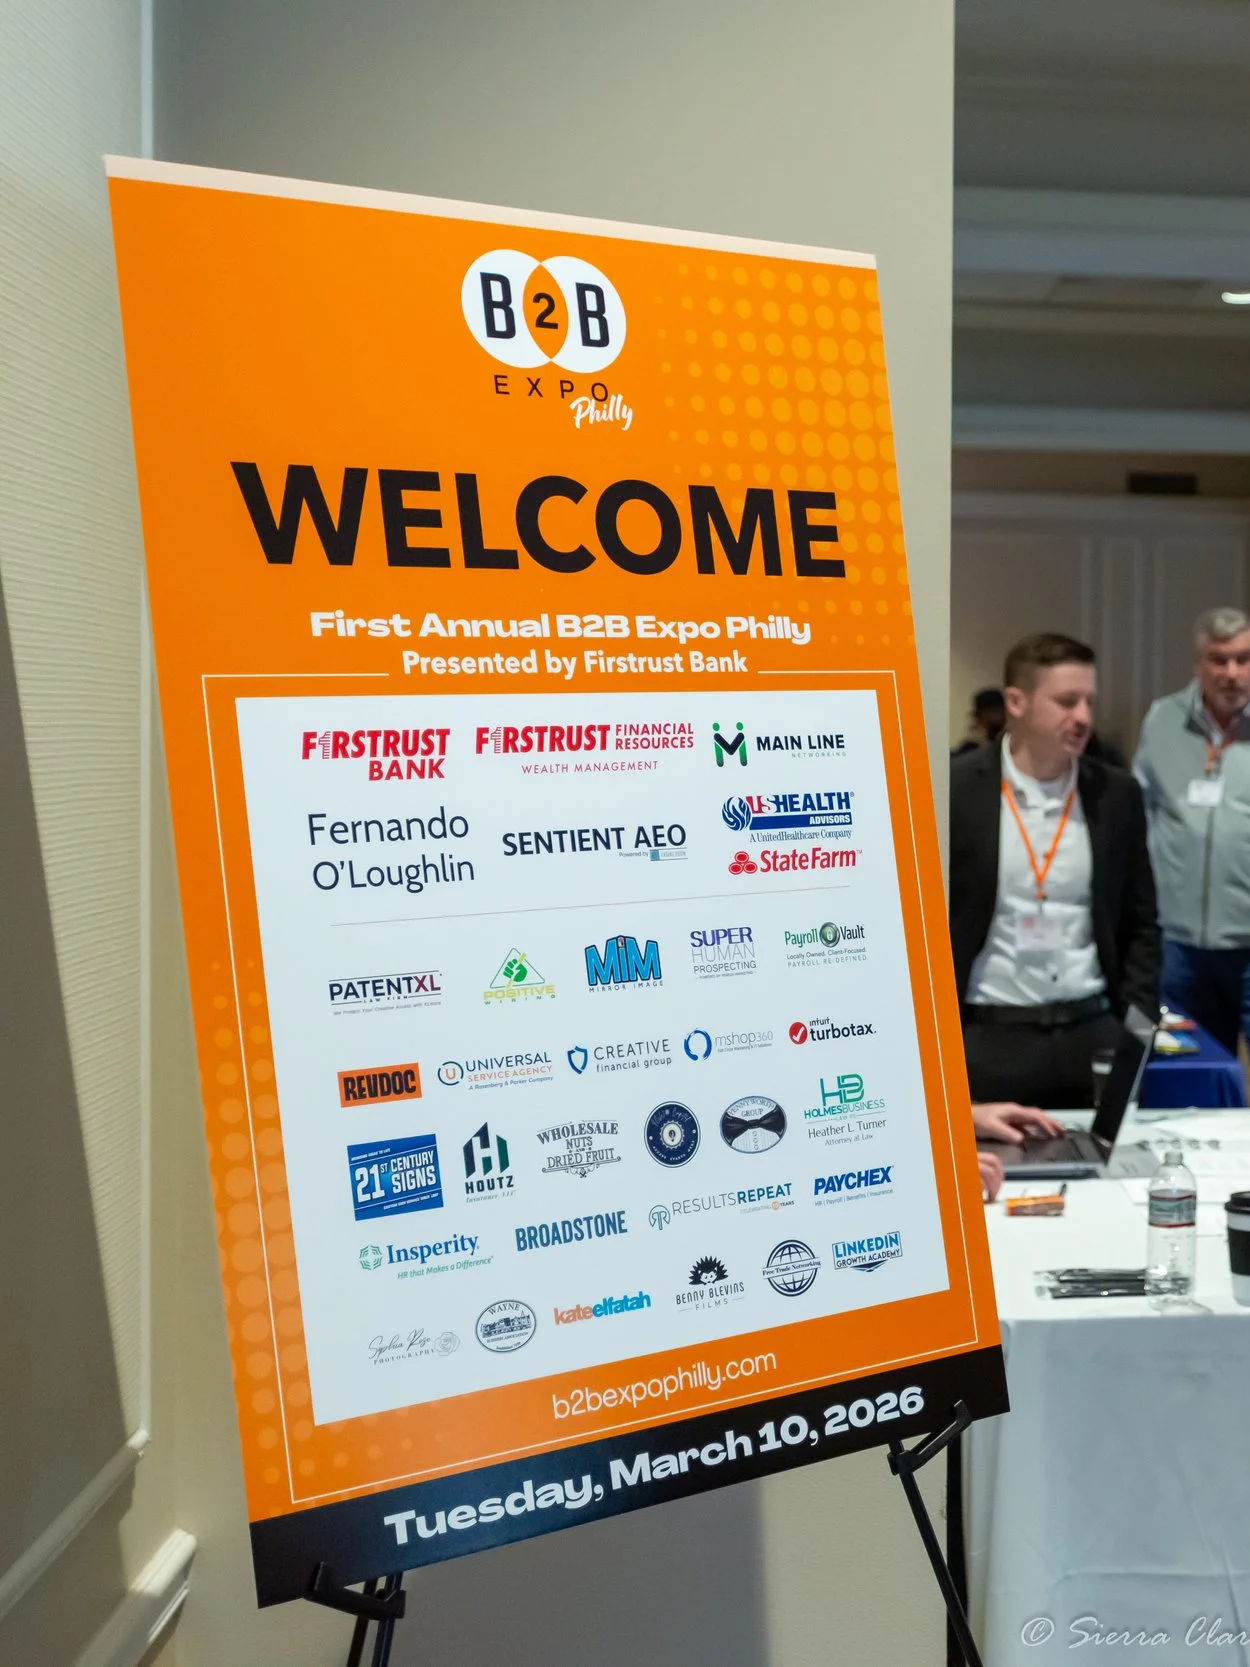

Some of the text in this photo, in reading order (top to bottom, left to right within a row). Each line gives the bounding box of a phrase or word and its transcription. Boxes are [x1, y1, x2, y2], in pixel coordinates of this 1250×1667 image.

[493, 374, 609, 403] EXPO
[569, 395, 633, 431] Philly
[229, 461, 847, 579] WELCOME
[310, 611, 811, 645] First Annual B2B Expo Philly
[402, 649, 748, 680] Presented by Firstrust Bank
[615, 723, 694, 736] FINANCIAL
[615, 737, 694, 750] RESOURCES
[756, 734, 845, 752] MAIN LINE
[791, 751, 847, 759] NETWORKING
[368, 758, 446, 781] BANK
[521, 760, 658, 775] WEALTH MANAGEMENT
[308, 806, 469, 846] Fernando
[809, 814, 851, 825] ADVISORS
[502, 824, 687, 856] SENTIENT AEO
[750, 828, 853, 843] A UnitedHealthcare Company
[690, 926, 753, 948] SUPER
[784, 924, 865, 948] Payroll Vault
[691, 941, 755, 963] HUMAN
[787, 952, 805, 960] Locally
[693, 960, 757, 974] PROSPECTING
[787, 960, 820, 968] PAYROLL
[328, 974, 441, 1001] PATENTXL
[483, 984, 556, 1001] POSITIVE
[589, 980, 664, 992] MIRROR IMAGE
[809, 1017, 830, 1026] intuit
[594, 1039, 671, 1060] CREATIVE
[466, 1051, 552, 1072] UNIVERSAL
[596, 1056, 672, 1073] financial group
[468, 1065, 553, 1082] SERVICE AGENCY
[343, 1069, 417, 1101] REVDOC
[536, 1122, 619, 1145] WHOLESALE
[808, 1125, 845, 1139] Heather
[856, 1120, 887, 1131] Turner
[566, 1136, 593, 1149] NUTS
[825, 1137, 852, 1146] Attorney
[390, 1150, 434, 1172] CENTURY
[547, 1148, 614, 1168] DRIED FRUIT
[391, 1165, 437, 1194] SIGNS
[465, 1175, 514, 1194] HOUTZ
[814, 1166, 892, 1196] PAYCHEX
[515, 1210, 628, 1251] BROADSTONE
[834, 1233, 899, 1258] LINKEDIN
[775, 1266, 791, 1274] Trade
[791, 1260, 821, 1271] Networking
[835, 1248, 900, 1268] GROWTH ACADEMY
[397, 1258, 492, 1280] HR that Makes a Difference
[676, 1281, 745, 1305] BENNY BLEVINS
[488, 1303, 521, 1315] WAYNE
[695, 1299, 729, 1311] FILMS
[373, 1348, 435, 1365] PHOTOGRAPHY
[553, 1350, 777, 1420] b2bexpophilly.com
[384, 1385, 925, 1546] Tuesday, March 10, 2026
